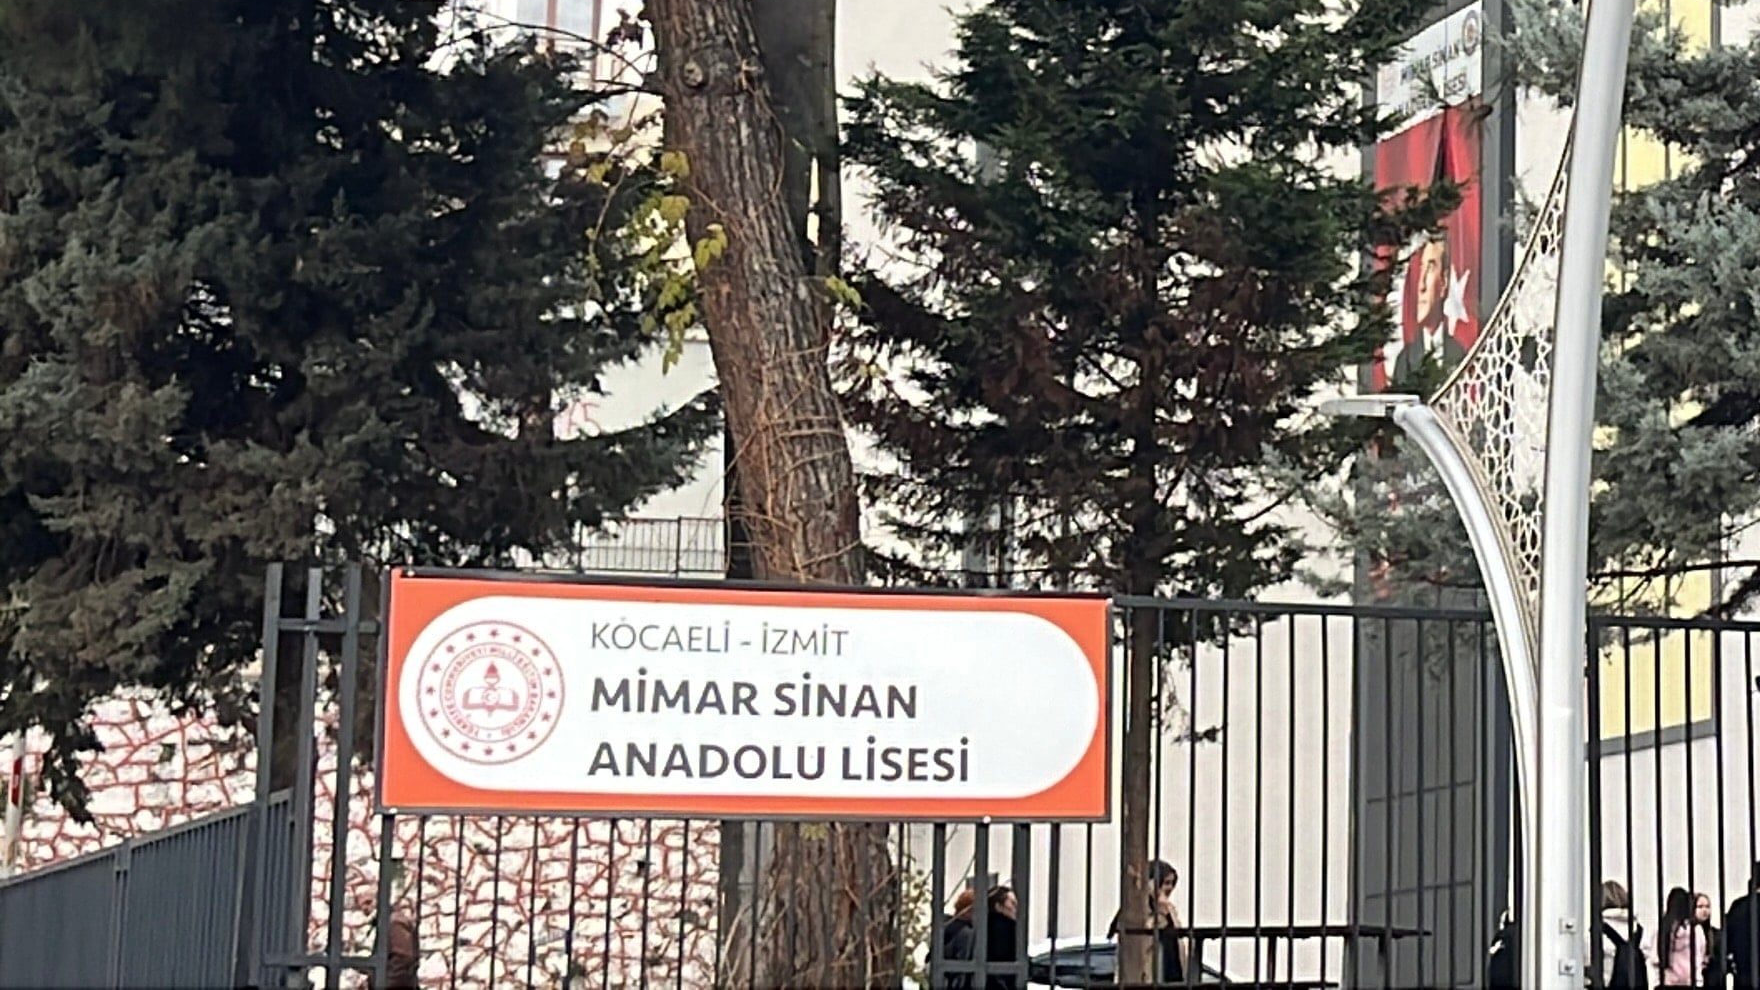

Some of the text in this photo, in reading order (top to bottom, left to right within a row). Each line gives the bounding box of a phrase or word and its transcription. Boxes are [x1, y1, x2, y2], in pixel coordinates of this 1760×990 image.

[761, 621, 849, 656] İZMİT
[590, 666, 761, 716] MİMAR
[773, 671, 917, 719] SİNAN
[586, 734, 969, 783] ANADOLU LİSESİ
